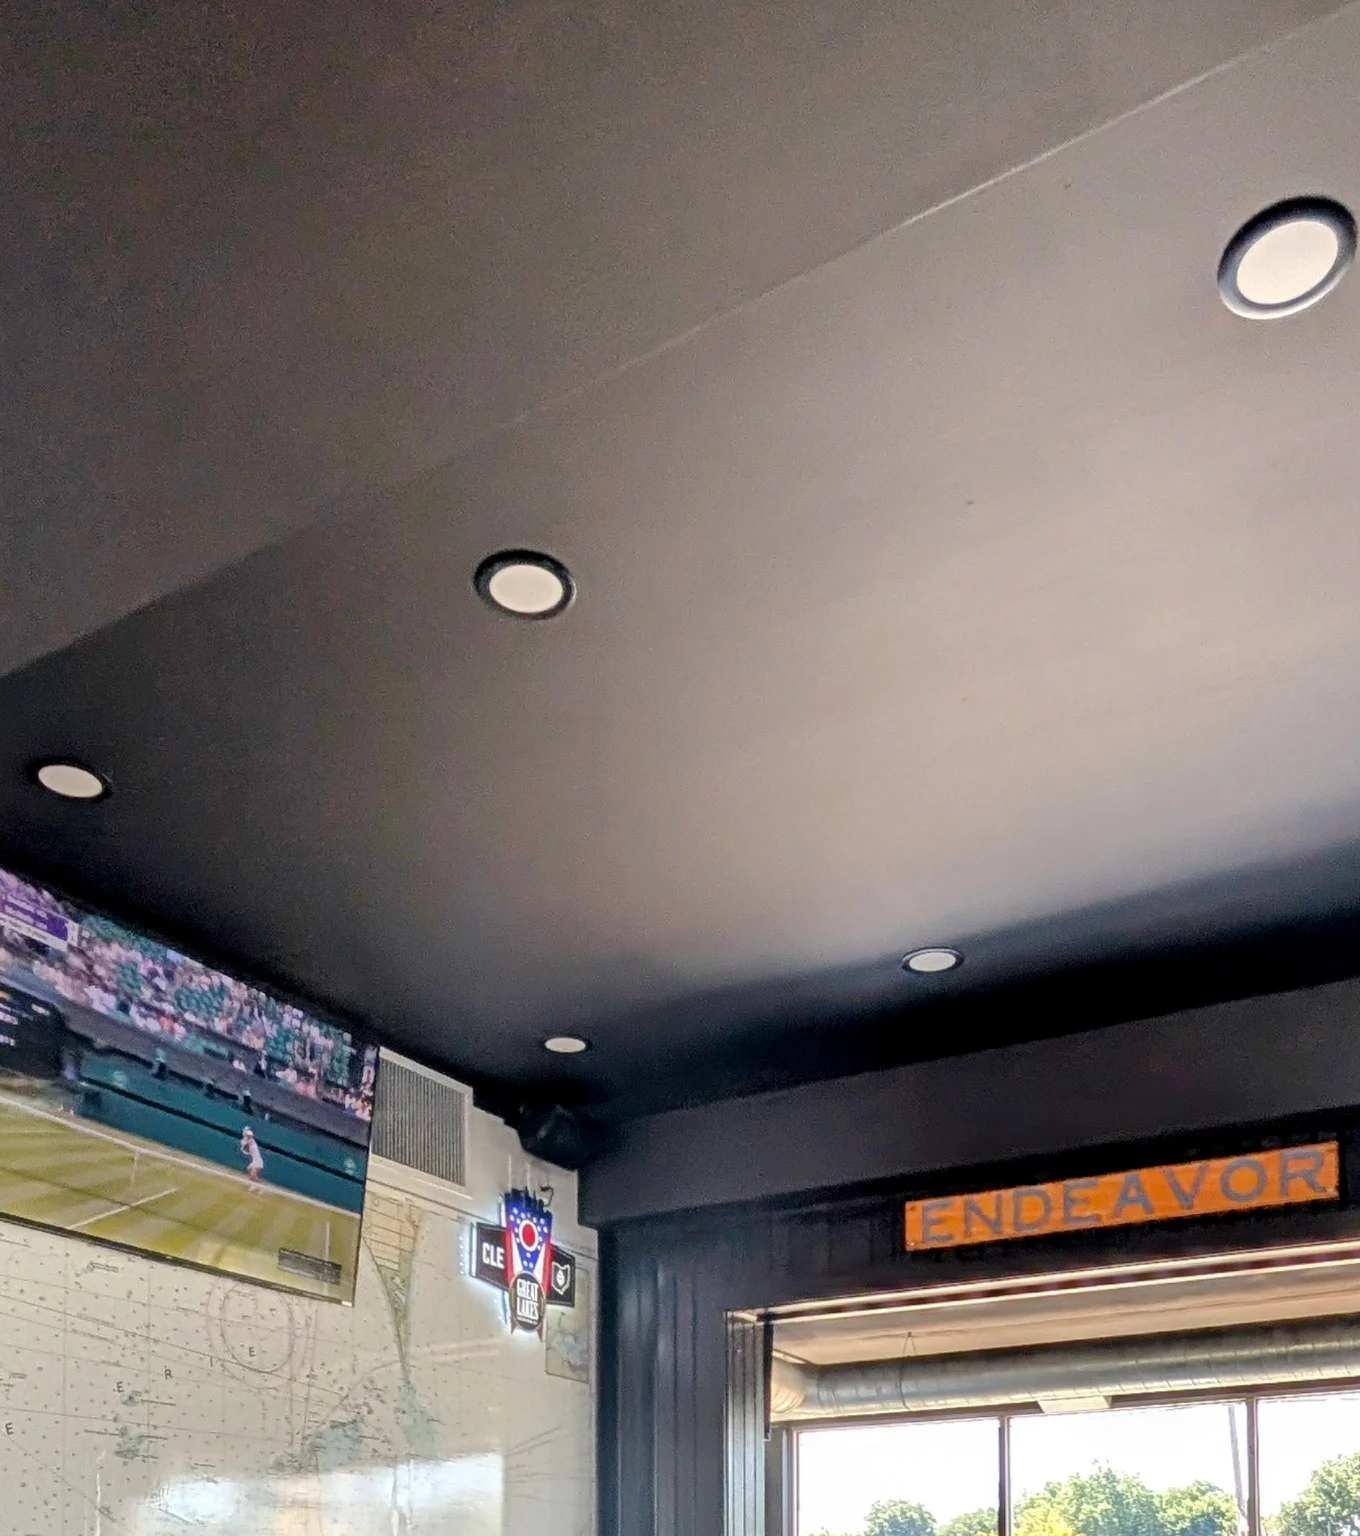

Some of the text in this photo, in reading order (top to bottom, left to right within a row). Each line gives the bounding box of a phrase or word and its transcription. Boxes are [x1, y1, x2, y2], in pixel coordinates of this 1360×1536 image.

[921, 1149, 1325, 1245] ENDEAVOR
[482, 1241, 506, 1270] CLE
[516, 1278, 539, 1301] GREAT
[516, 1297, 539, 1320] LAKES
